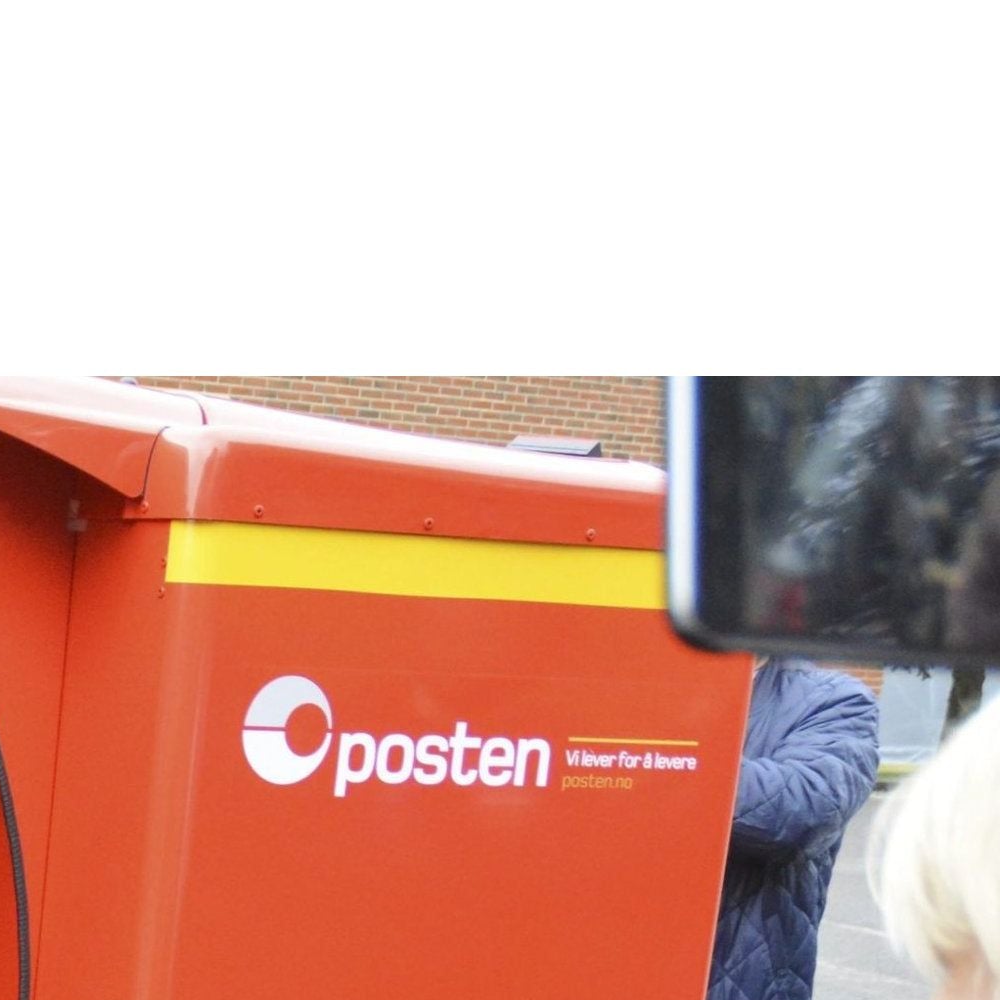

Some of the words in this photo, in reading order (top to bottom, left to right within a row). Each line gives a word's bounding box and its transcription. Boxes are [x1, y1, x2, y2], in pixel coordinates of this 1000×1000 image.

[334, 721, 551, 797] posten
[565, 749, 580, 767] Vi
[581, 750, 617, 768] lever
[618, 751, 642, 769] for
[643, 752, 653, 769] å
[654, 752, 697, 770] levere
[561, 774, 634, 791] posten.no
